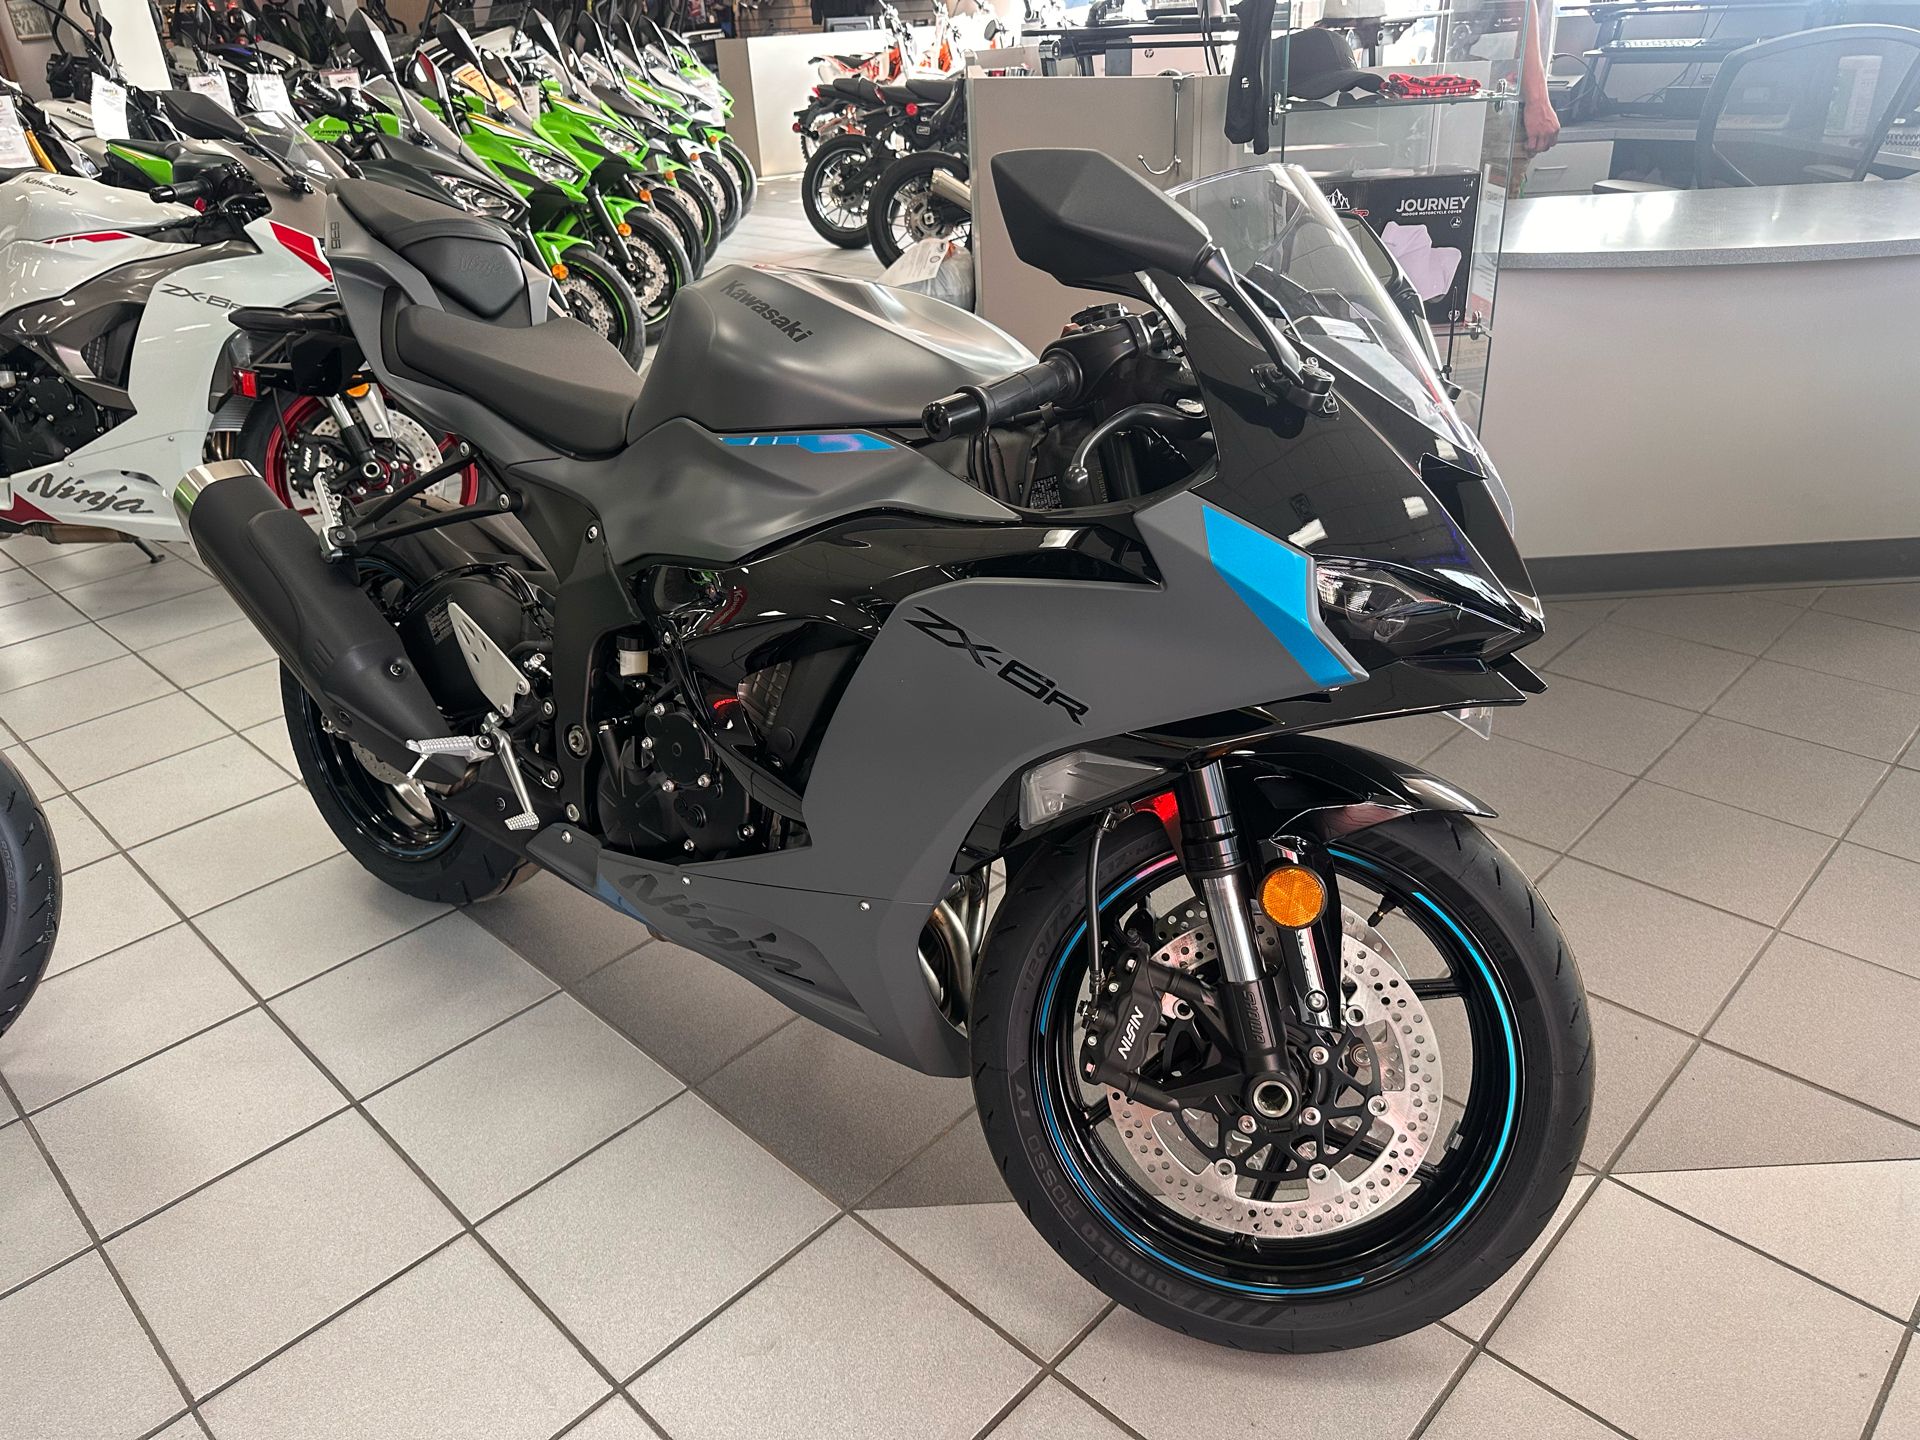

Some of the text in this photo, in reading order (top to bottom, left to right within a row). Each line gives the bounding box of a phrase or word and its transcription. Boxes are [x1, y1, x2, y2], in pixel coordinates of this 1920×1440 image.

[22, 177, 78, 196] Kawasaki
[1395, 196, 1470, 213] JOURNEY
[718, 279, 815, 344] Kawasaki
[26, 472, 154, 514] Ninja
[903, 605, 1089, 726] ZX-6R
[618, 873, 816, 985] Ninja
[1116, 1005, 1145, 1060] NISSIN
[1015, 1084, 1174, 1297] DIABLO ROSSO IV
